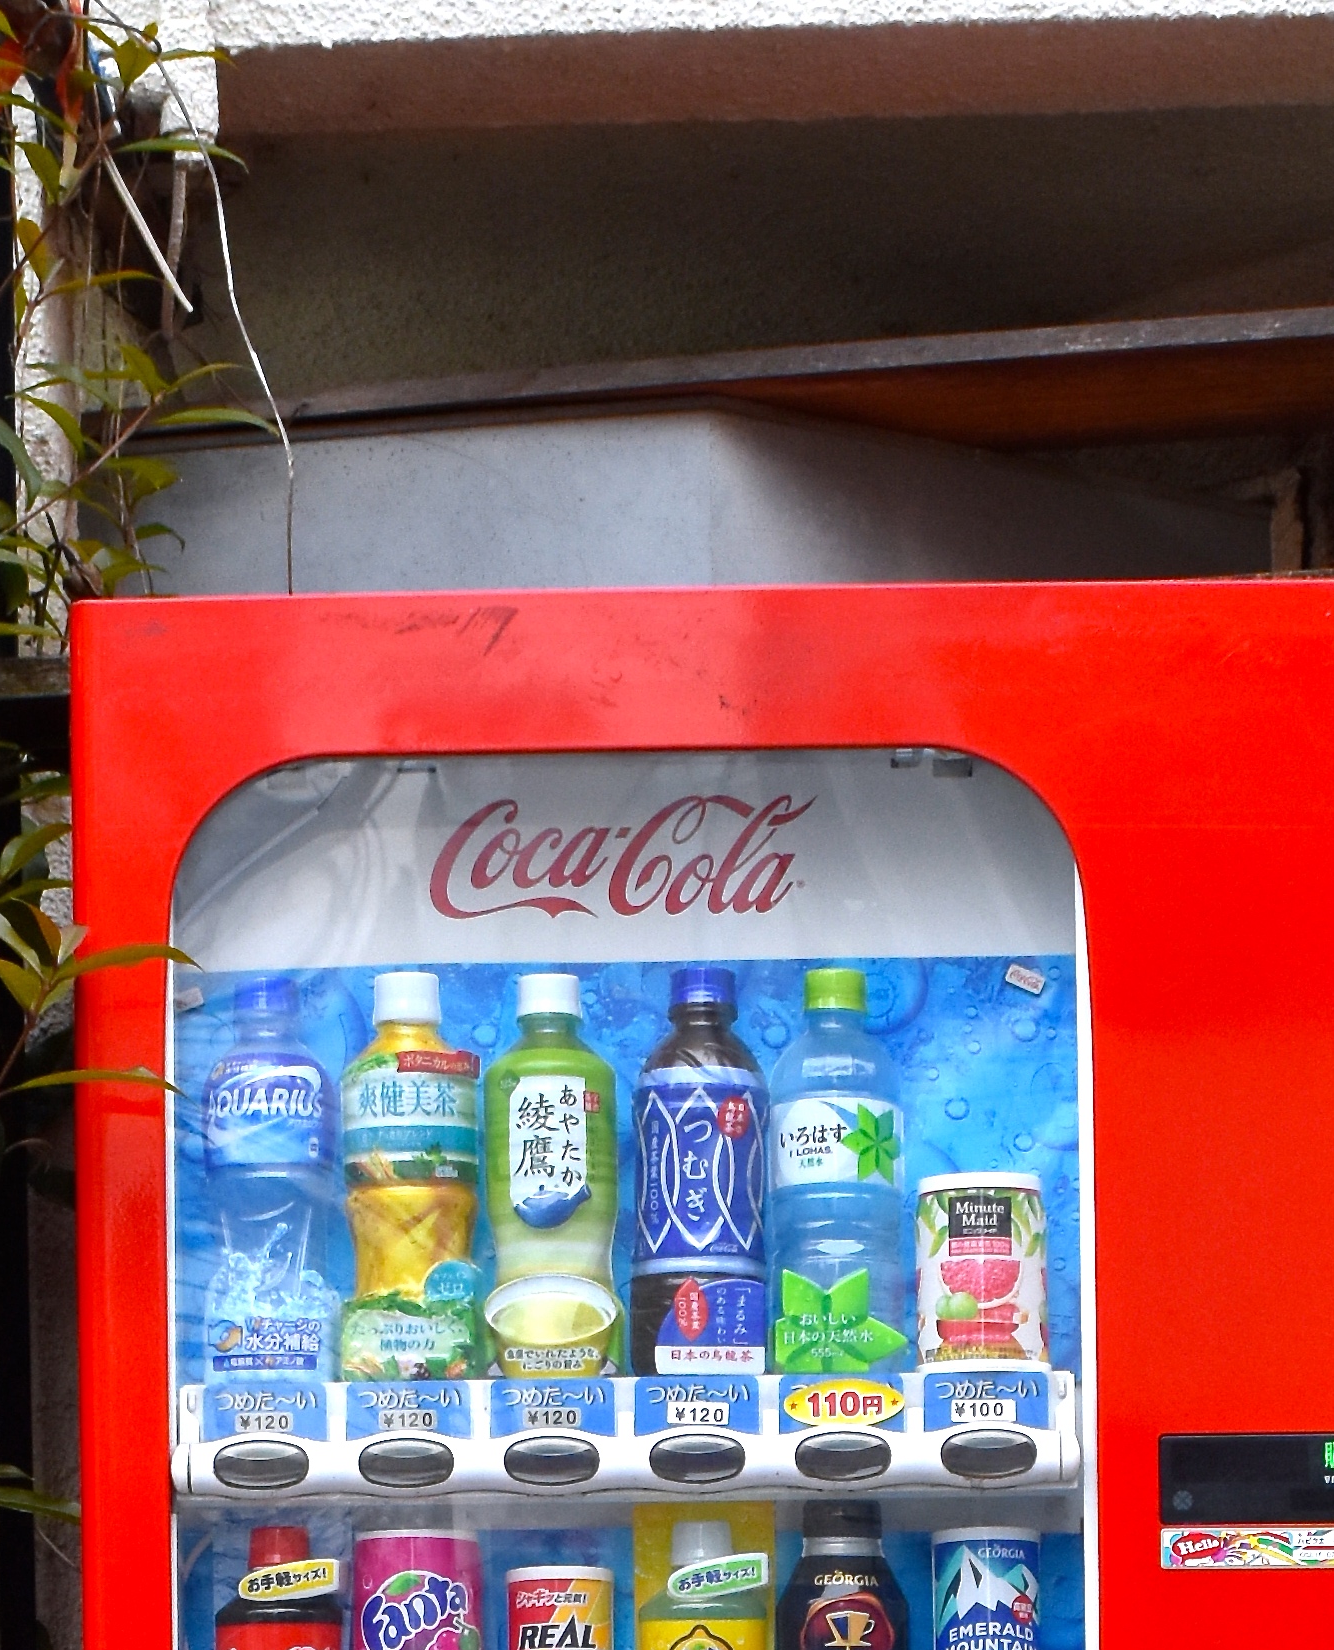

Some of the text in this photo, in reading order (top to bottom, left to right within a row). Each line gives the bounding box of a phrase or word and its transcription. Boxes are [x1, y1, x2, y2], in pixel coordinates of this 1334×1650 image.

[429, 794, 817, 919] Coca-Cola
[207, 1087, 323, 1122] AQUARIUS
[359, 1081, 457, 1117] 爽健美茶
[514, 1093, 560, 1180] 綾鷹
[558, 1084, 582, 1186] あやたか
[780, 1123, 848, 1148] いろはす
[682, 1119, 713, 1222] つむぎ
[955, 1201, 1005, 1215] Minute
[961, 1214, 998, 1227] Maid
[799, 1312, 856, 1326] おいしい
[245, 1333, 321, 1352] 水分補給
[784, 1329, 874, 1346] 日本の天然水
[807, 1391, 884, 1418] 110円
[955, 1402, 1004, 1418] ¥100
[239, 1415, 290, 1431] ¥120
[382, 1412, 434, 1429] ¥120
[527, 1410, 577, 1426] ¥120
[674, 1407, 725, 1424] ¥120
[1177, 1537, 1220, 1556] Hello
[246, 1567, 328, 1593] お手軽サイズ!
[677, 1567, 756, 1593] お手軽サイズ!
[949, 1621, 1035, 1643] EMERALD
